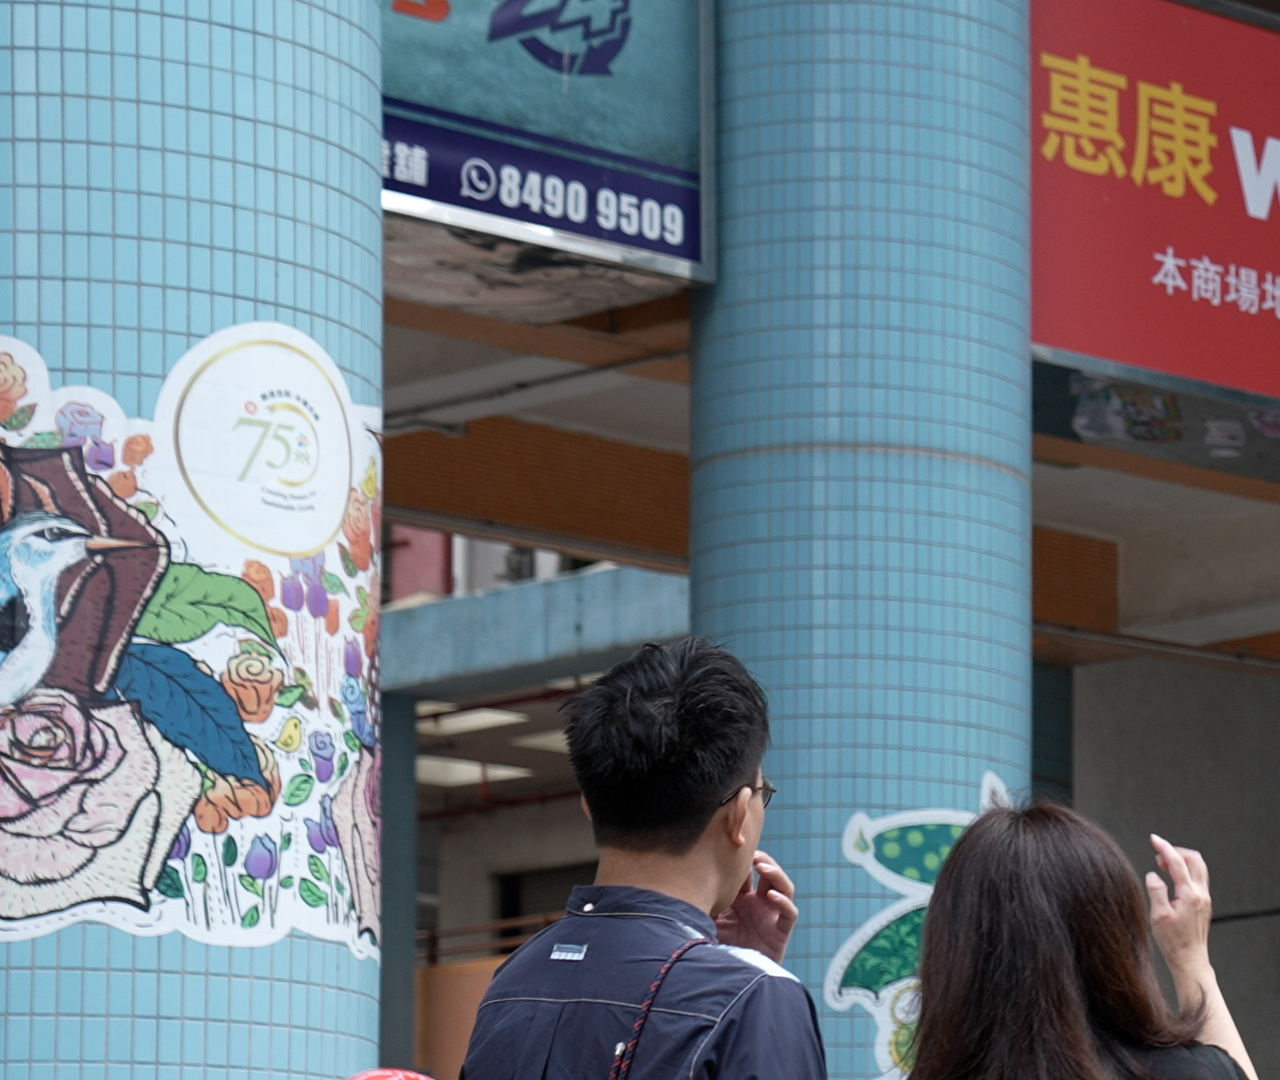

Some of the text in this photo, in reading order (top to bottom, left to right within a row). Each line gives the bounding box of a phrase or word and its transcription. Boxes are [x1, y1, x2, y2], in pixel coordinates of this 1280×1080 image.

[1040, 52, 1218, 206] 惠康
[499, 164, 684, 246] 8490 9509
